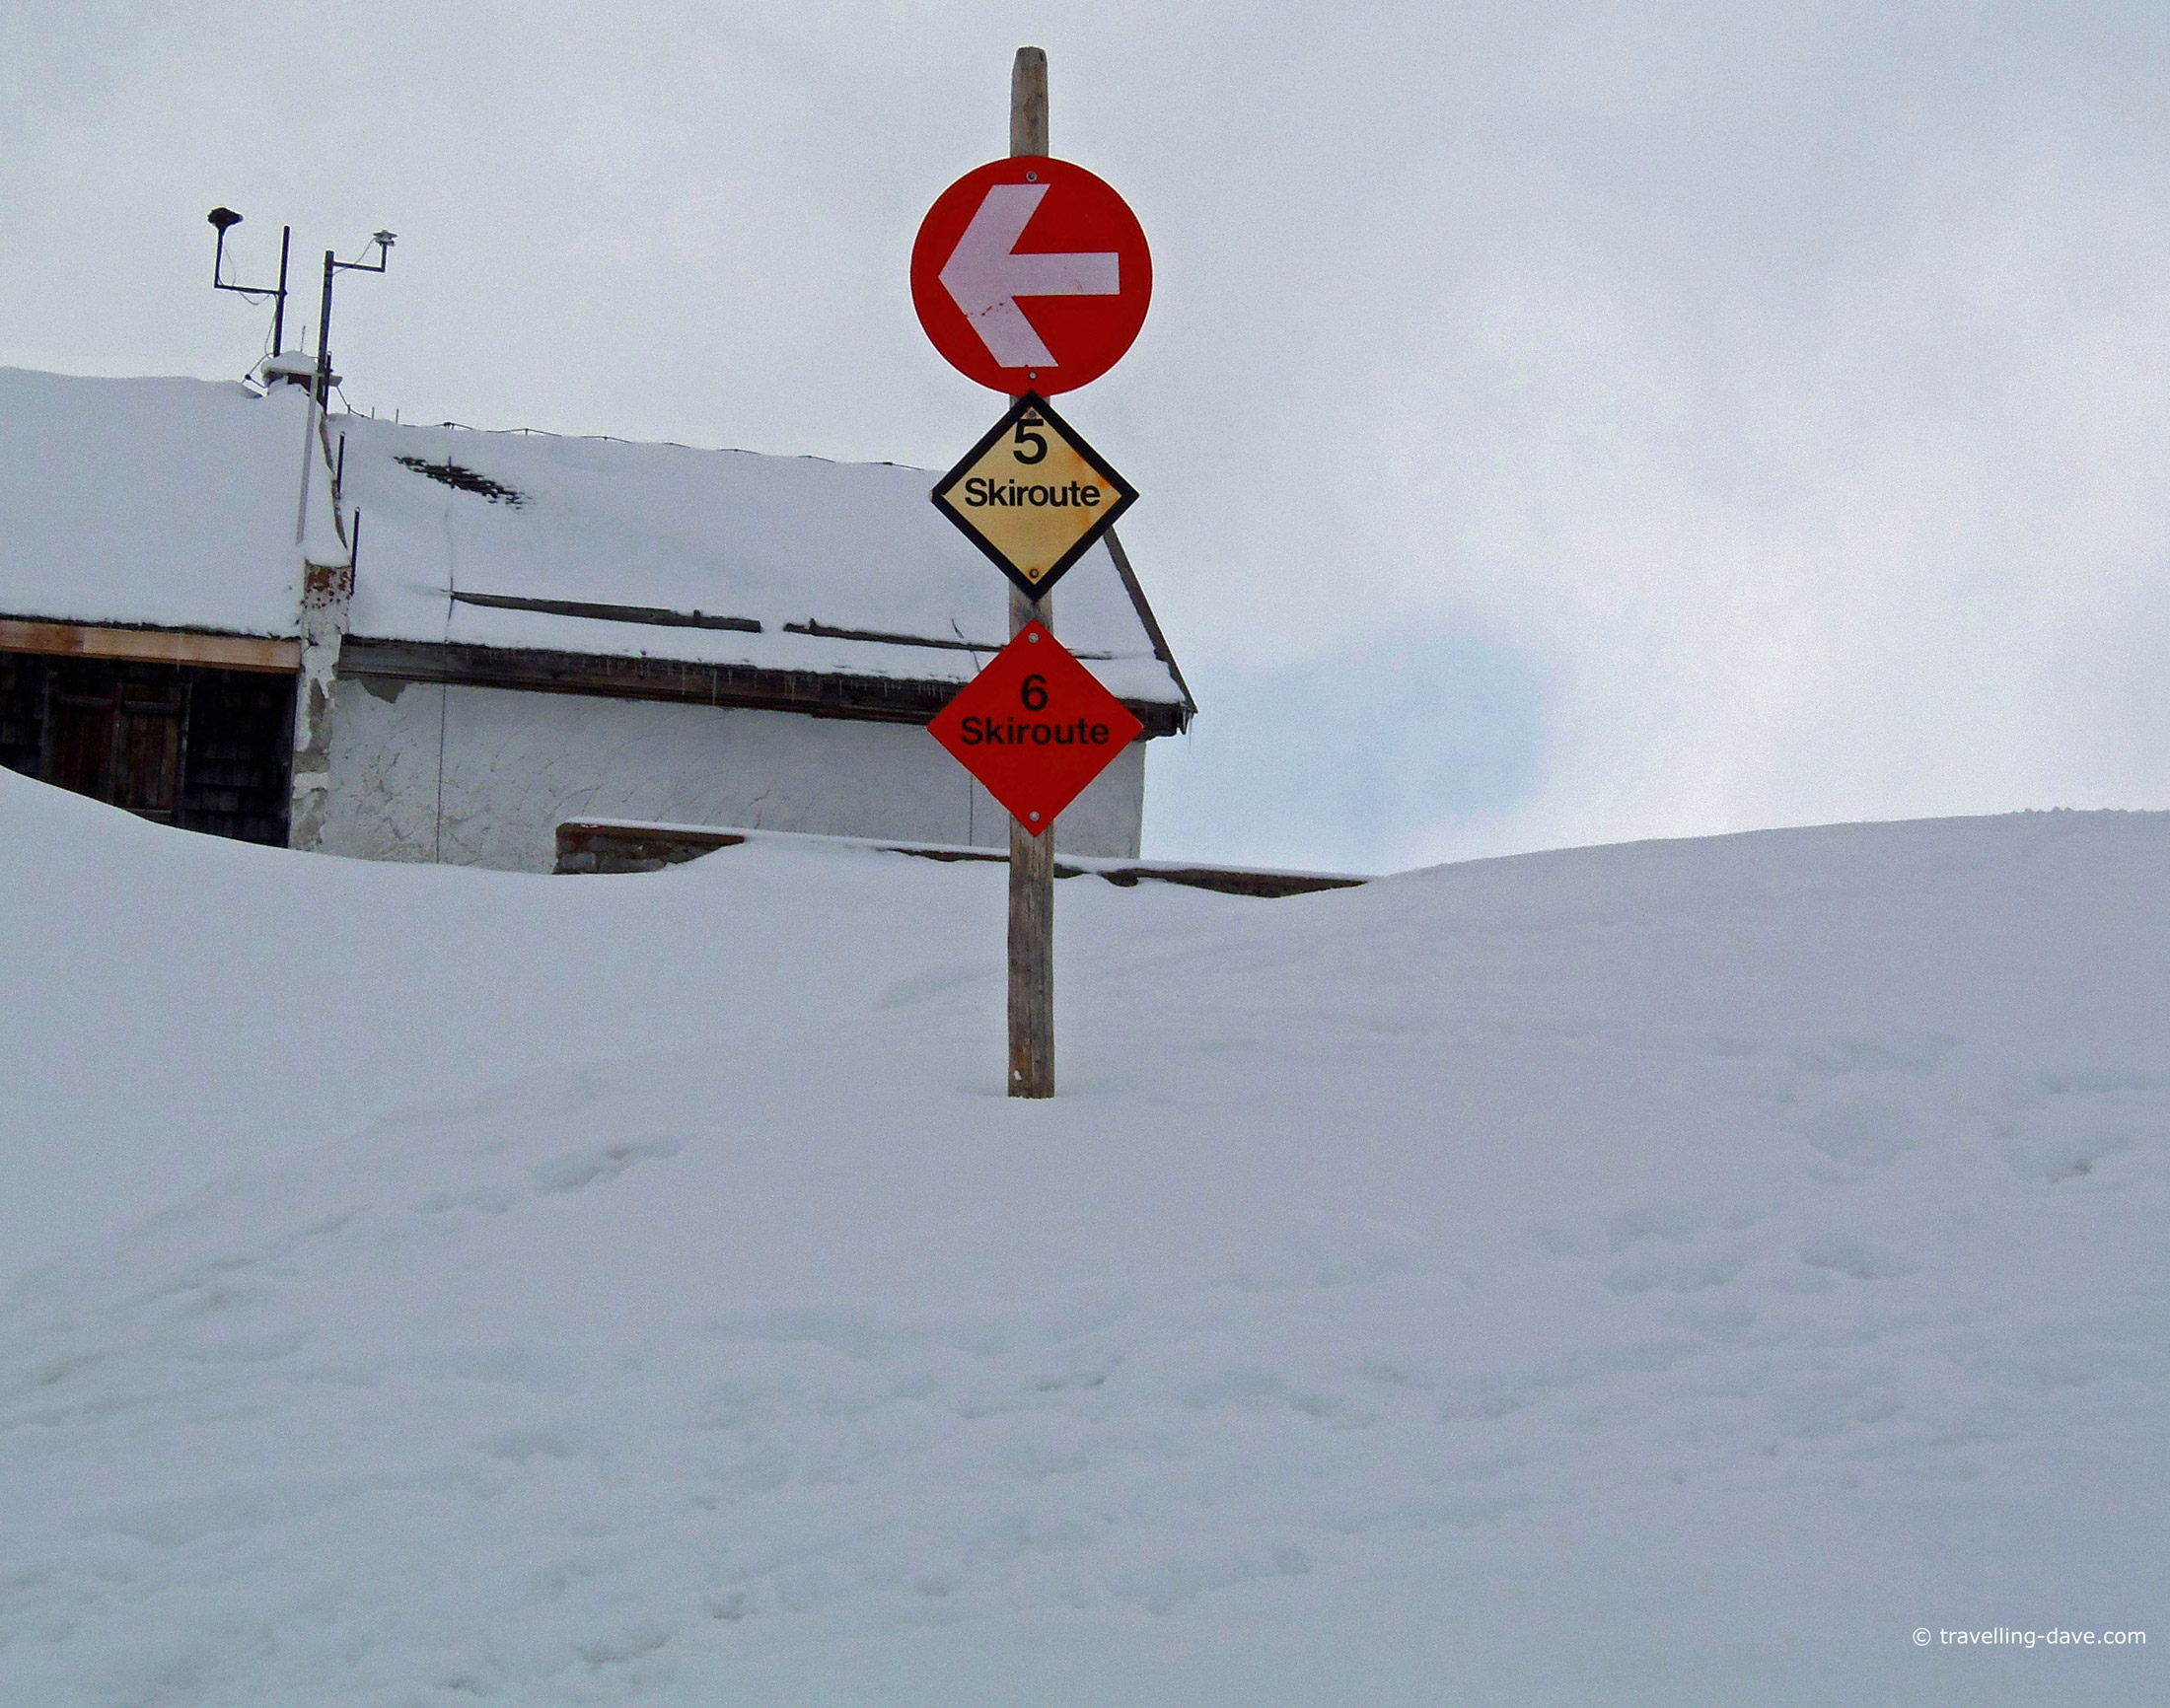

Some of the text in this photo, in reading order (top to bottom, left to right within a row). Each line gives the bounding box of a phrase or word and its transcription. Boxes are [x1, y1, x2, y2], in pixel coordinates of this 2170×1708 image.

[1013, 419, 1048, 464] 5
[965, 478, 1101, 507] Skiroute
[1021, 674, 1049, 712] 6
[960, 716, 1110, 746] Skiroute
